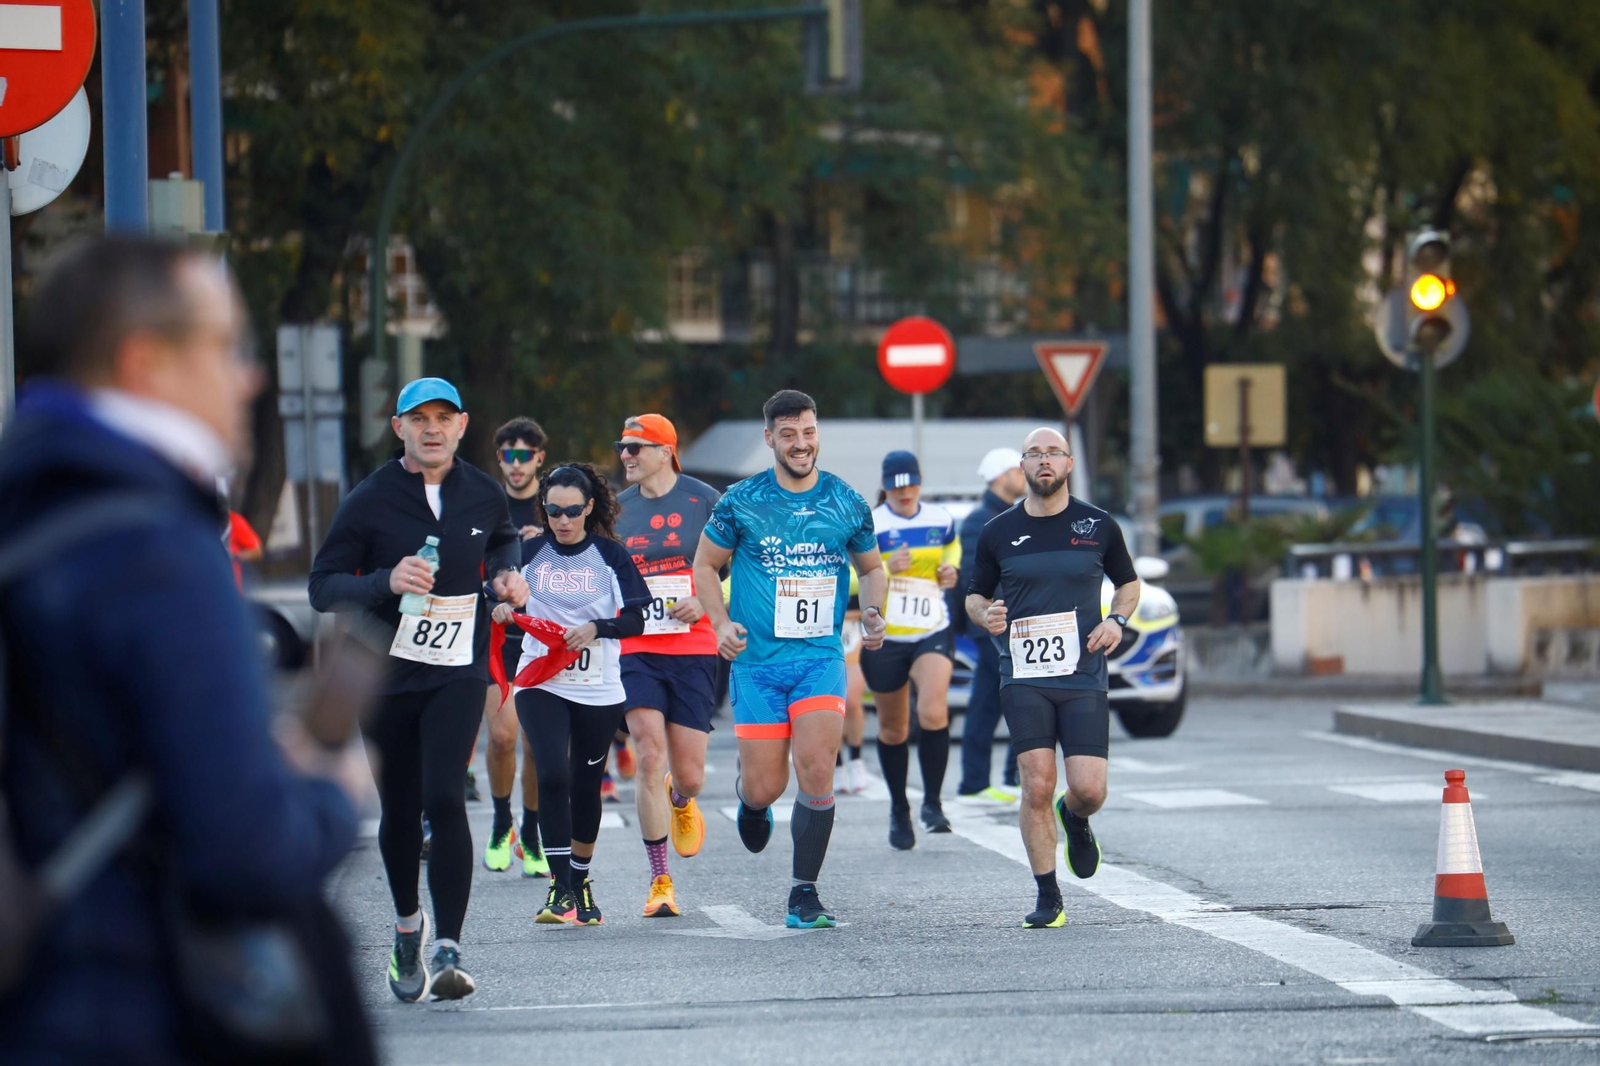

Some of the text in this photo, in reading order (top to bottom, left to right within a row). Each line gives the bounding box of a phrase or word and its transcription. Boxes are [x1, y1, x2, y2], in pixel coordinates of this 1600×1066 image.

[760, 552, 846, 568] 38 MARATÓN
[785, 542, 826, 556] MEDIA
[535, 562, 598, 593] fest
[779, 579, 798, 597] XLI
[796, 598, 819, 624] 61
[901, 595, 930, 617] 110
[412, 619, 462, 650] 827
[1023, 636, 1066, 664] 223
